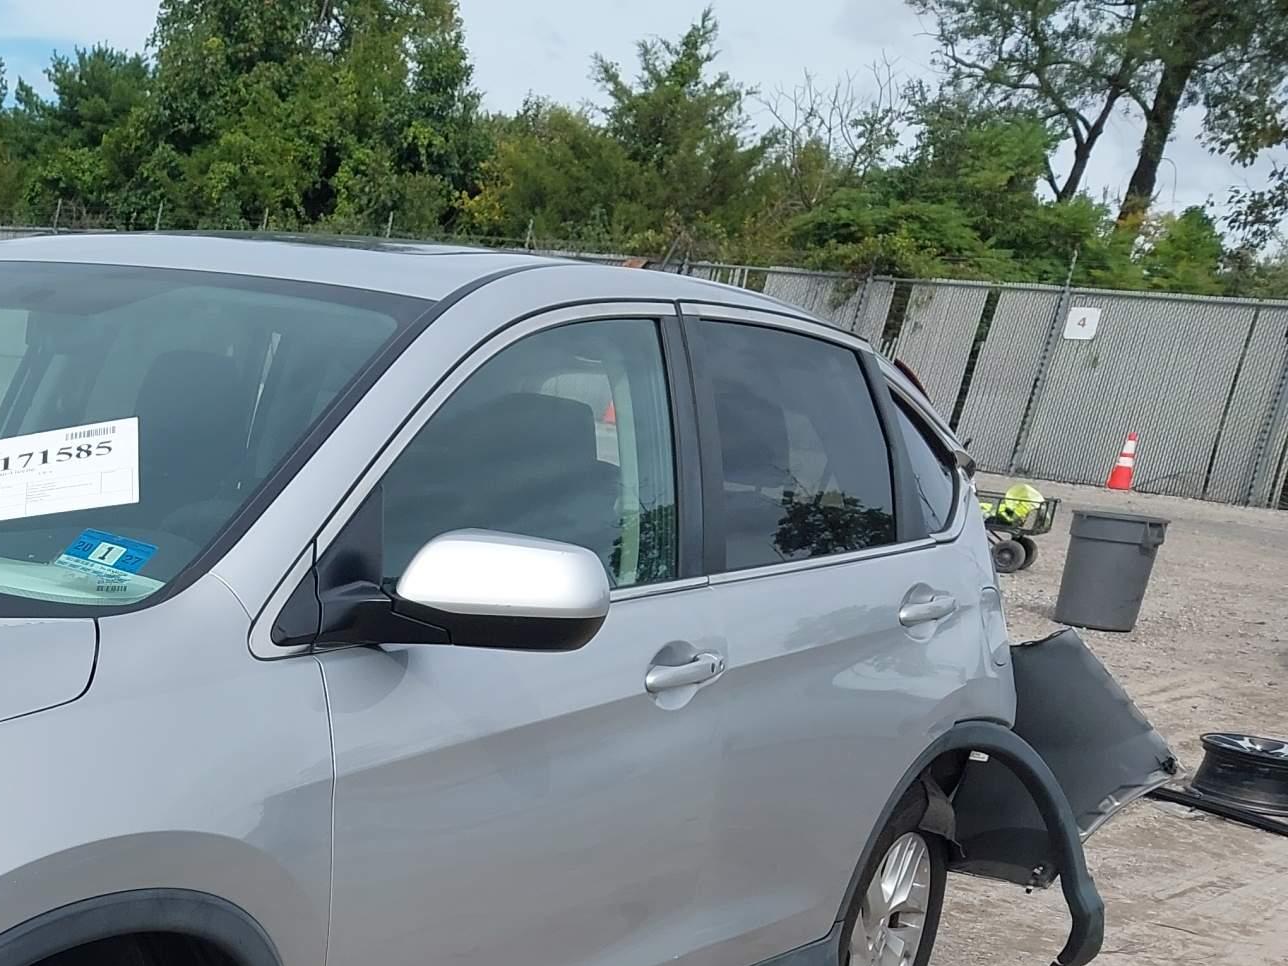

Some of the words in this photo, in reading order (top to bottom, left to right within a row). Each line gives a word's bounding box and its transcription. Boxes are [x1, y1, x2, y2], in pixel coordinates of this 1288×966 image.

[1077, 317, 1087, 328] 4
[73, 540, 94, 553] 20
[98, 546, 114, 561] 1
[121, 554, 143, 566] 27
